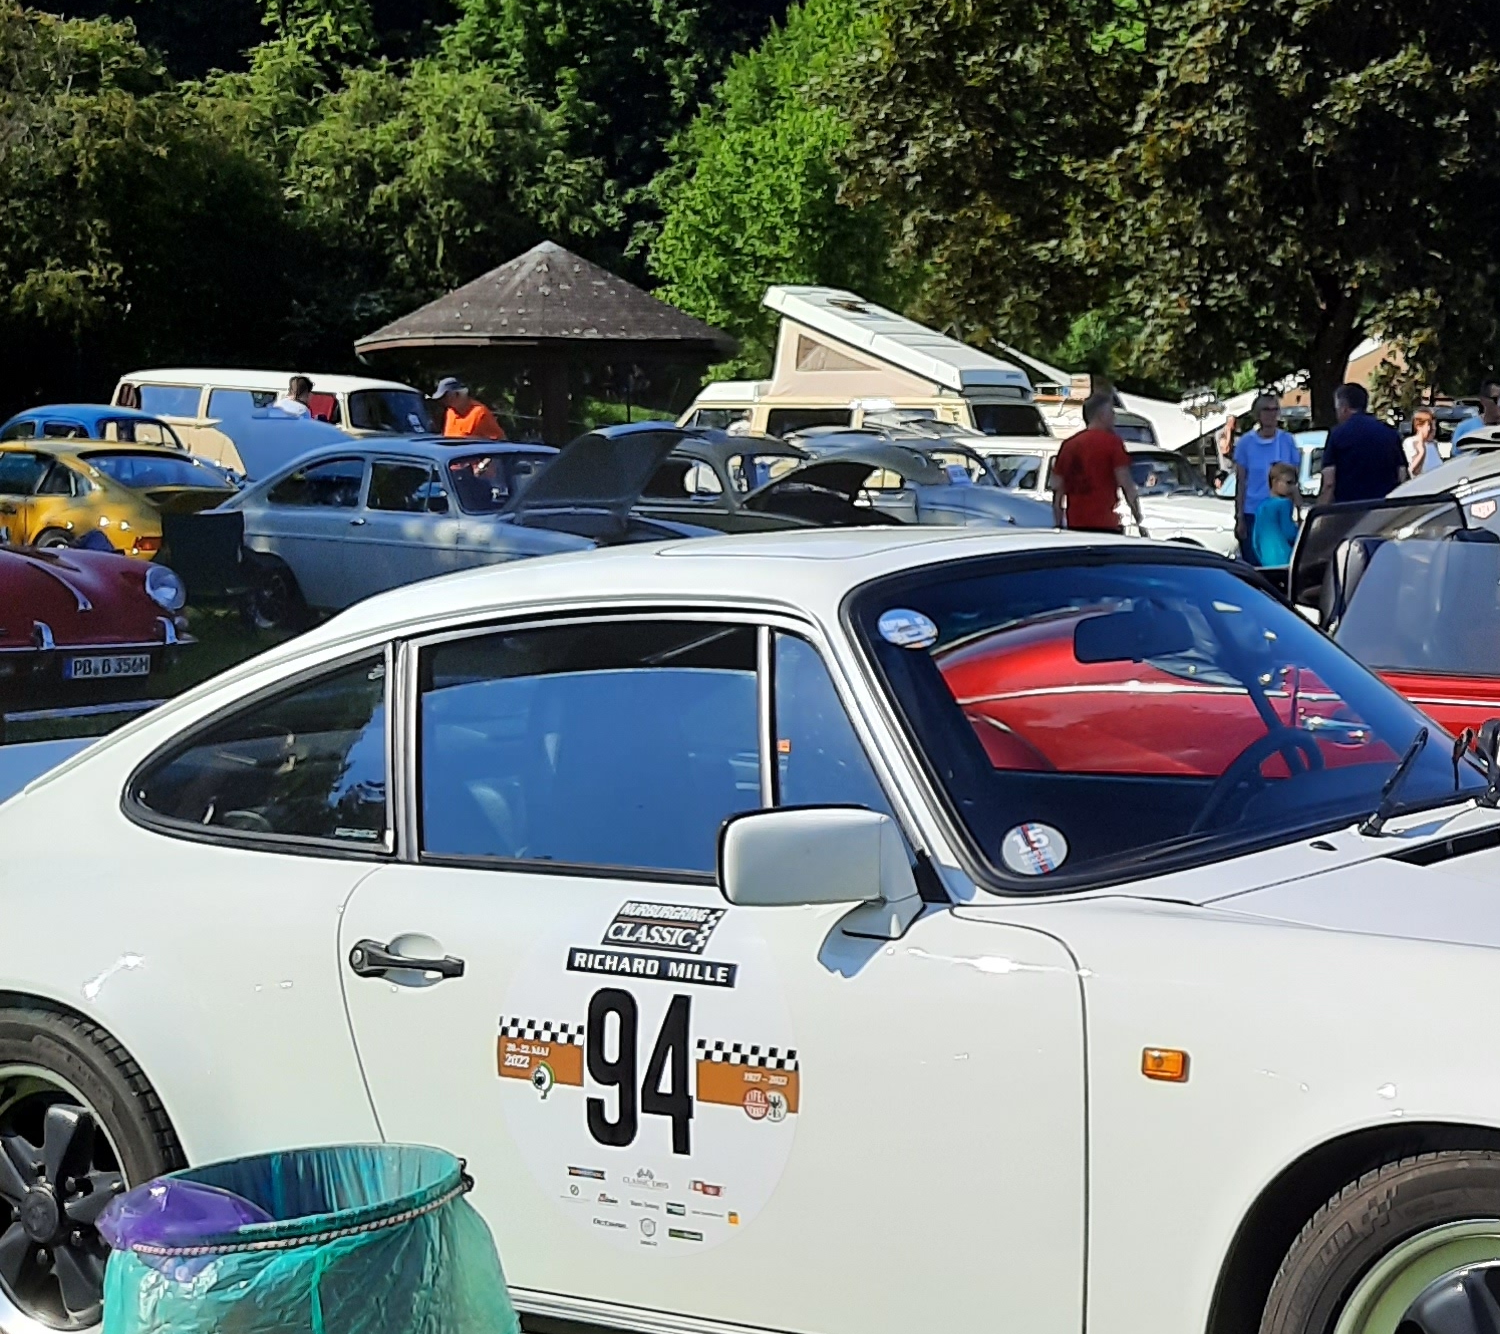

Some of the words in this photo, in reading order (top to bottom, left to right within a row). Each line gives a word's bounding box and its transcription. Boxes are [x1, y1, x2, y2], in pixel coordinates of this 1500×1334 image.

[74, 659, 92, 676] PB
[608, 923, 697, 946] CLASSIC
[573, 952, 660, 976] RICHARD
[667, 962, 730, 983] MILLE
[586, 987, 694, 1155] 94
